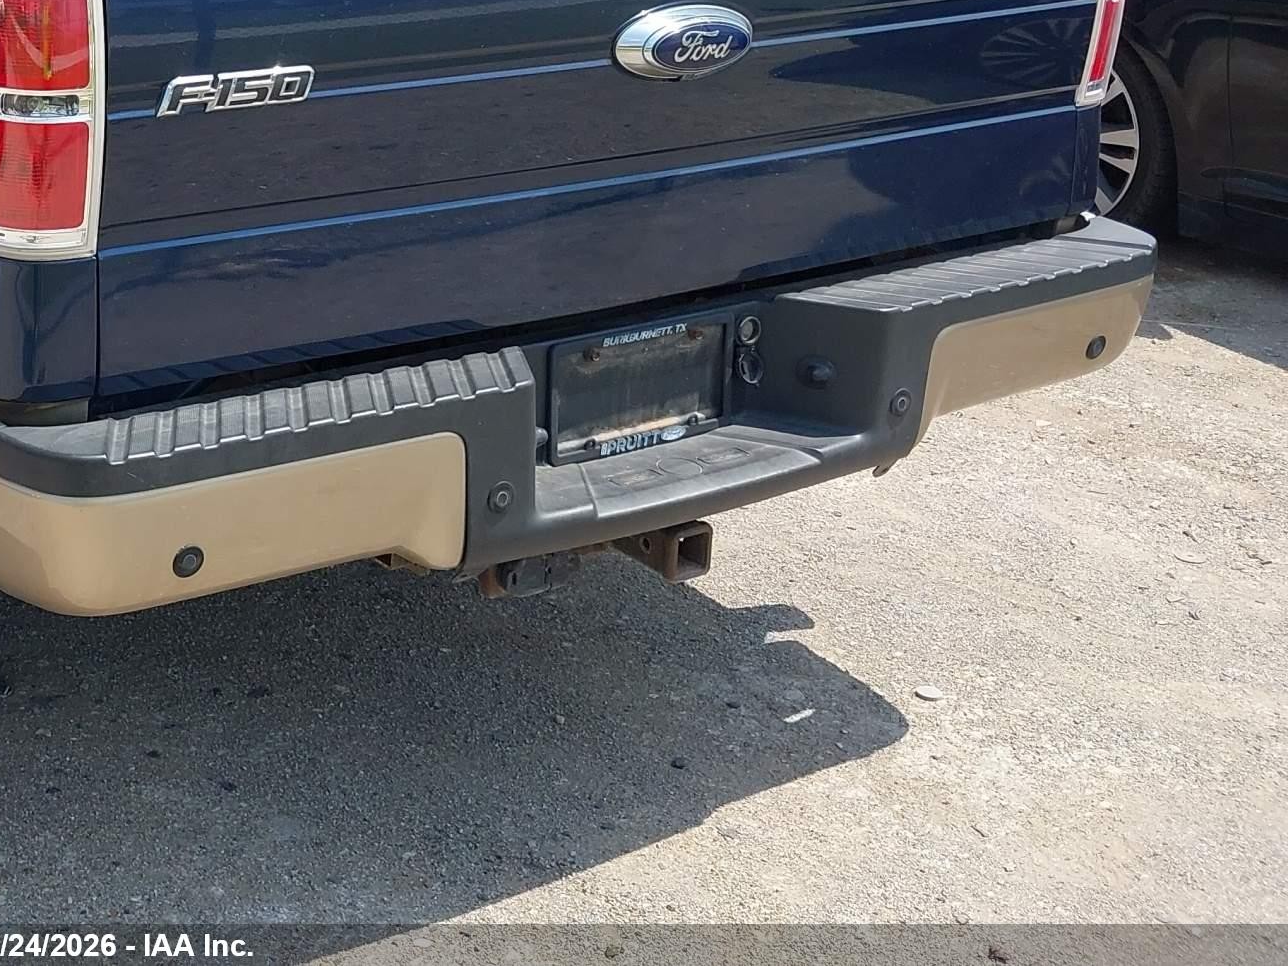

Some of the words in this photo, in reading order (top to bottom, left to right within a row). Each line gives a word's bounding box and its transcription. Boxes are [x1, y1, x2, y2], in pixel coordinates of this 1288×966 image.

[674, 29, 733, 63] Ford
[156, 65, 315, 118] F-150
[606, 429, 662, 455] PRUITT
